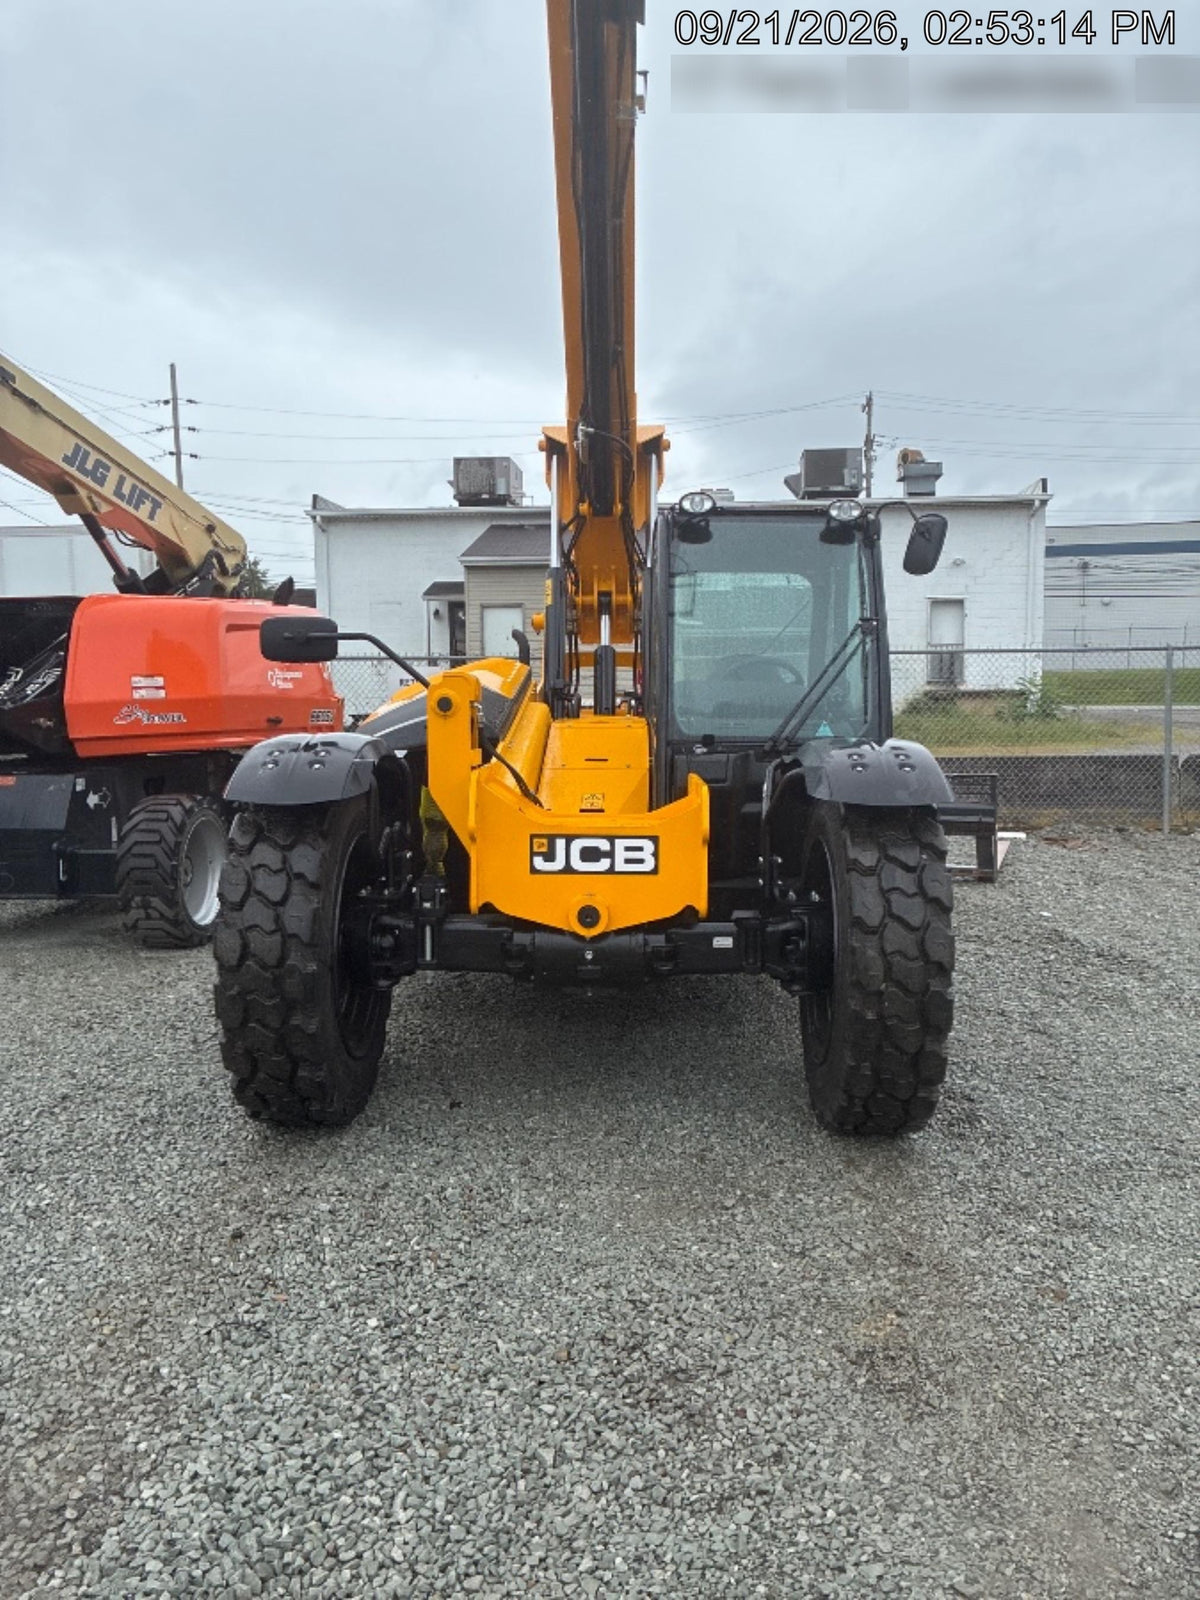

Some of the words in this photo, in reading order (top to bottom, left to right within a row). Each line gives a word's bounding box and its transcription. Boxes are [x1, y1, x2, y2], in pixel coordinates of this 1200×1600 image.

[62, 442, 111, 488] JLG
[113, 474, 163, 521] LIFT
[533, 838, 655, 872] JCB
